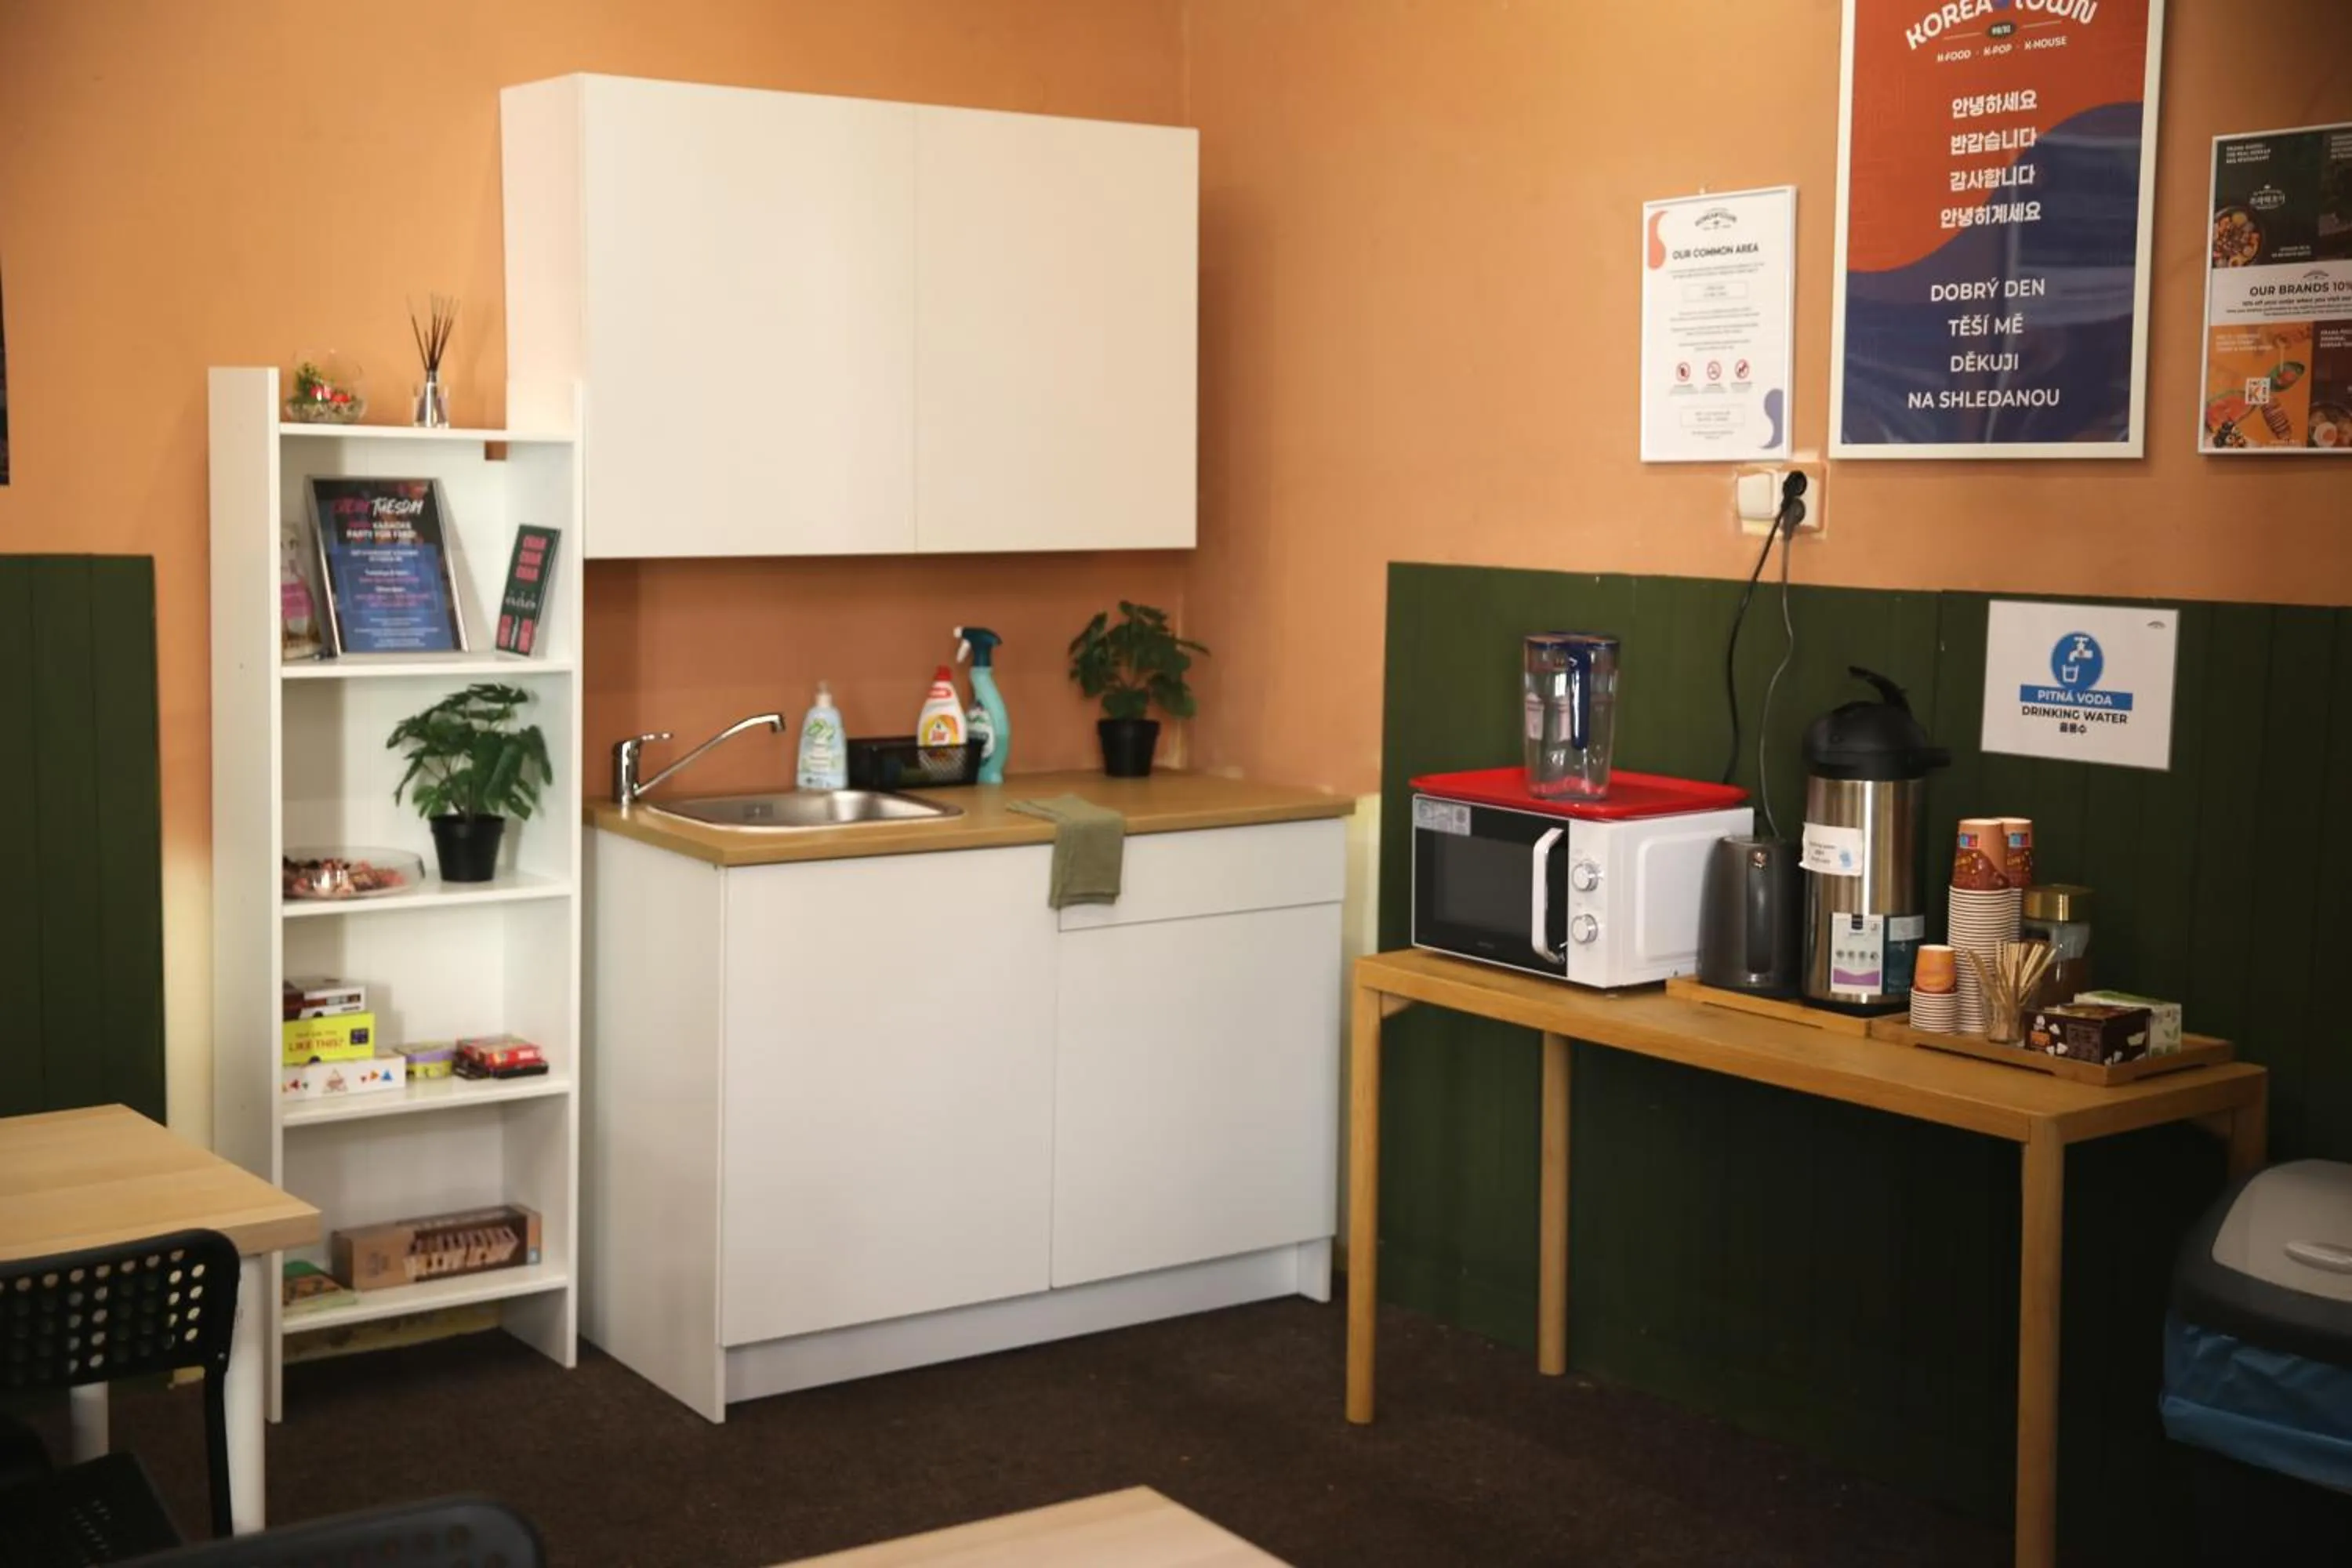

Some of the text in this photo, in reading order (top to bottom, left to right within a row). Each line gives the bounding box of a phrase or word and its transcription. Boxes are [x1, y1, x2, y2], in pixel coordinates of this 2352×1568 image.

[1905, 0, 1994, 51] KOREA
[1951, 89, 2038, 119] 안녕하세요
[1950, 126, 2038, 155] 반갑습니다
[1950, 164, 2036, 192] 감사합니다
[1671, 242, 1759, 260] OUR COMMON AREA
[1930, 278, 2045, 302] DOBRÝ DEN
[2249, 285, 2276, 297] OUR
[2278, 282, 2329, 296] BRANDS
[1948, 313, 2024, 337] TĚŠÍ MĚ
[1950, 351, 2020, 372] DĚKUJI
[1907, 389, 2060, 409] NA SHLEDANOU
[2038, 689, 2113, 706] PITNÁ VODA
[2021, 705, 2128, 724] DRINKING WATER
